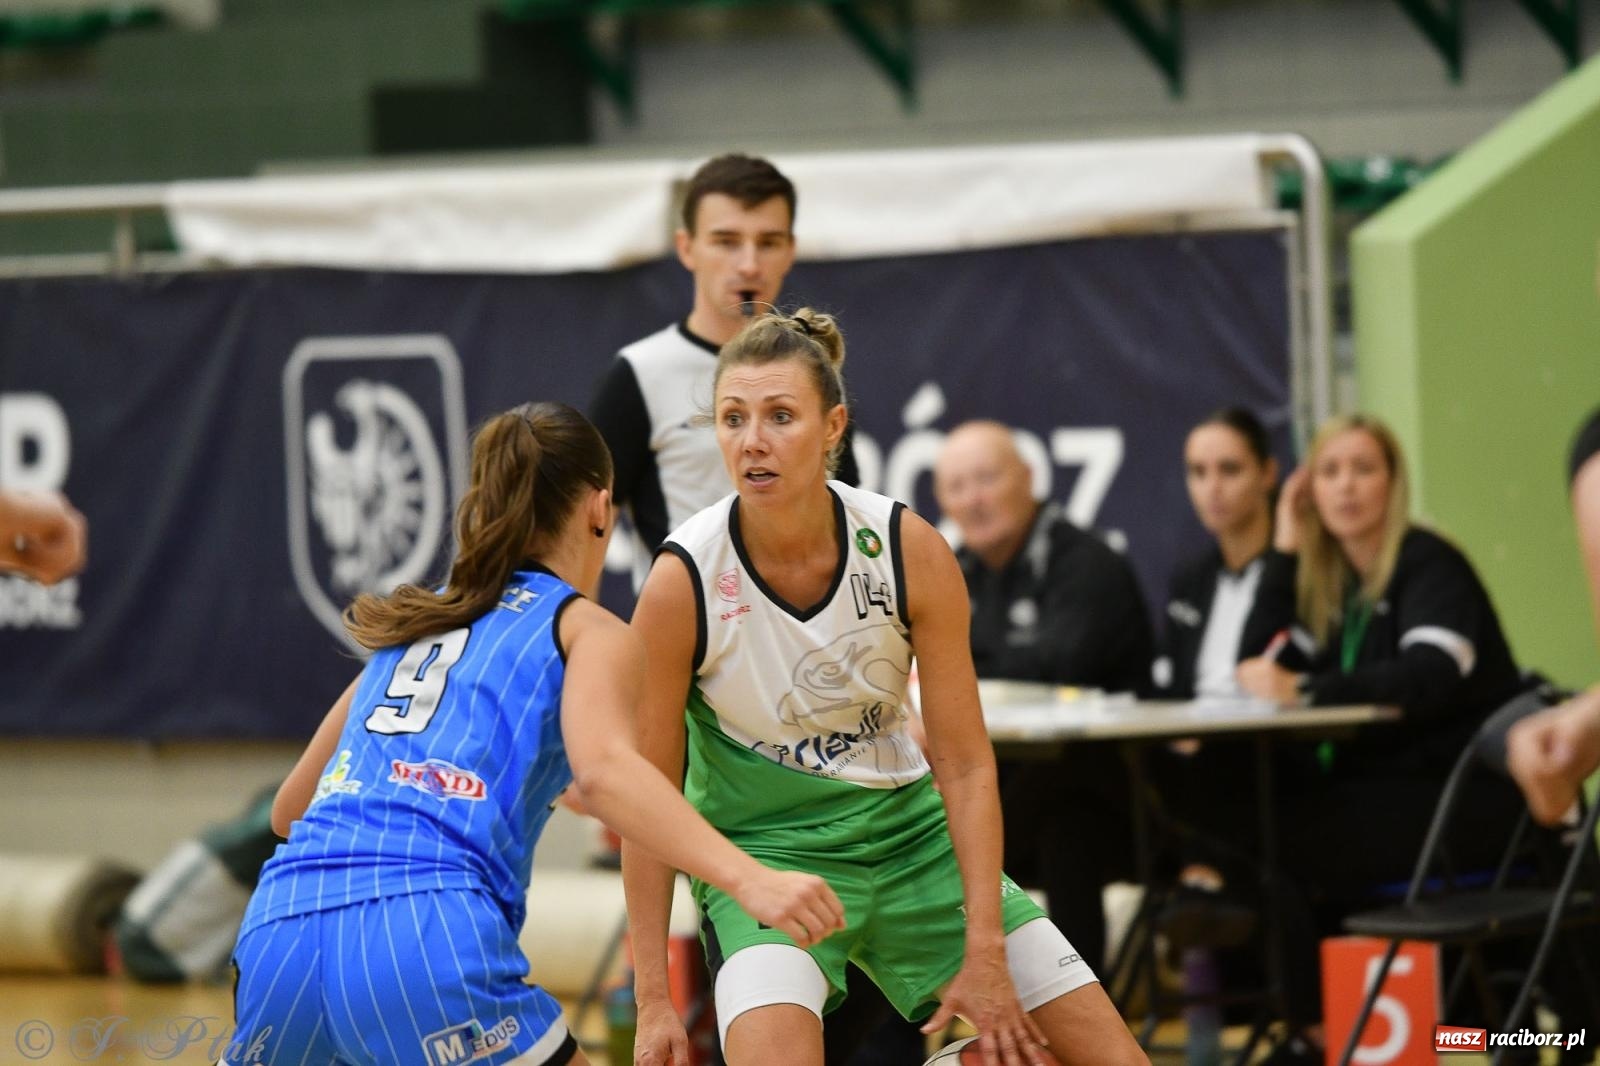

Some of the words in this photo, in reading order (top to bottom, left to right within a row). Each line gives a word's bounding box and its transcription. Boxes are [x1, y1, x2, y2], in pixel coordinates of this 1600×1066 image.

[850, 573, 893, 620] 14
[364, 626, 471, 735] 9
[1346, 954, 1413, 1064] 5
